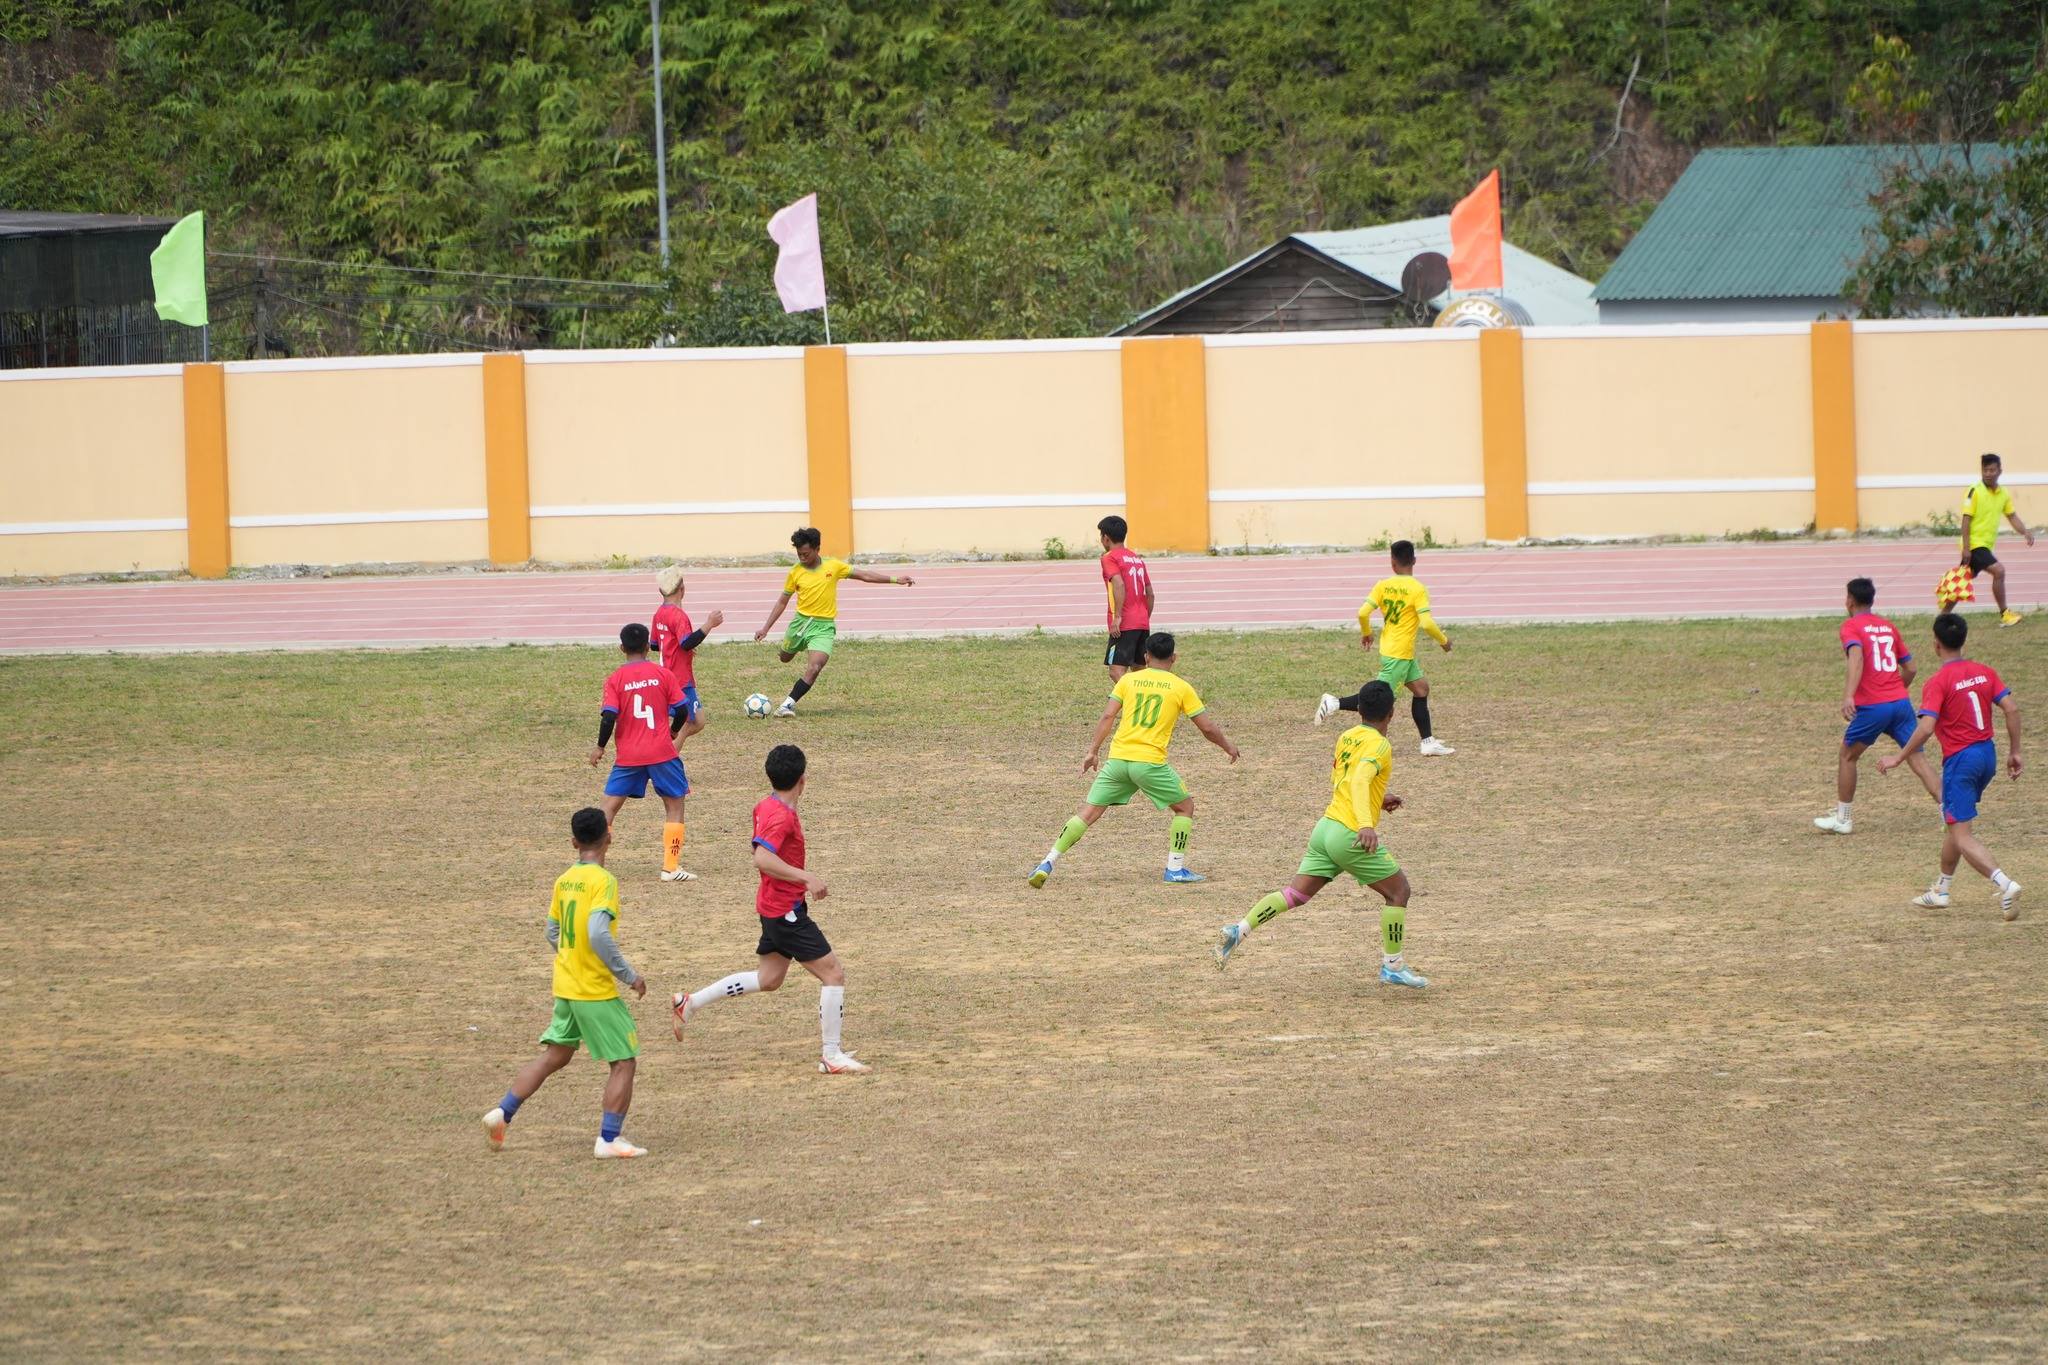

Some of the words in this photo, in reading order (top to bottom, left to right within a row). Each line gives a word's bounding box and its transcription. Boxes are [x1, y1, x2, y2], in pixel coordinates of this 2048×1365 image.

[1128, 566, 1146, 596] 11
[1869, 634, 1897, 672] 13
[633, 693, 655, 730] 4
[1131, 693, 1163, 728] 10
[1968, 690, 1985, 731] 1
[559, 899, 577, 949] 14
